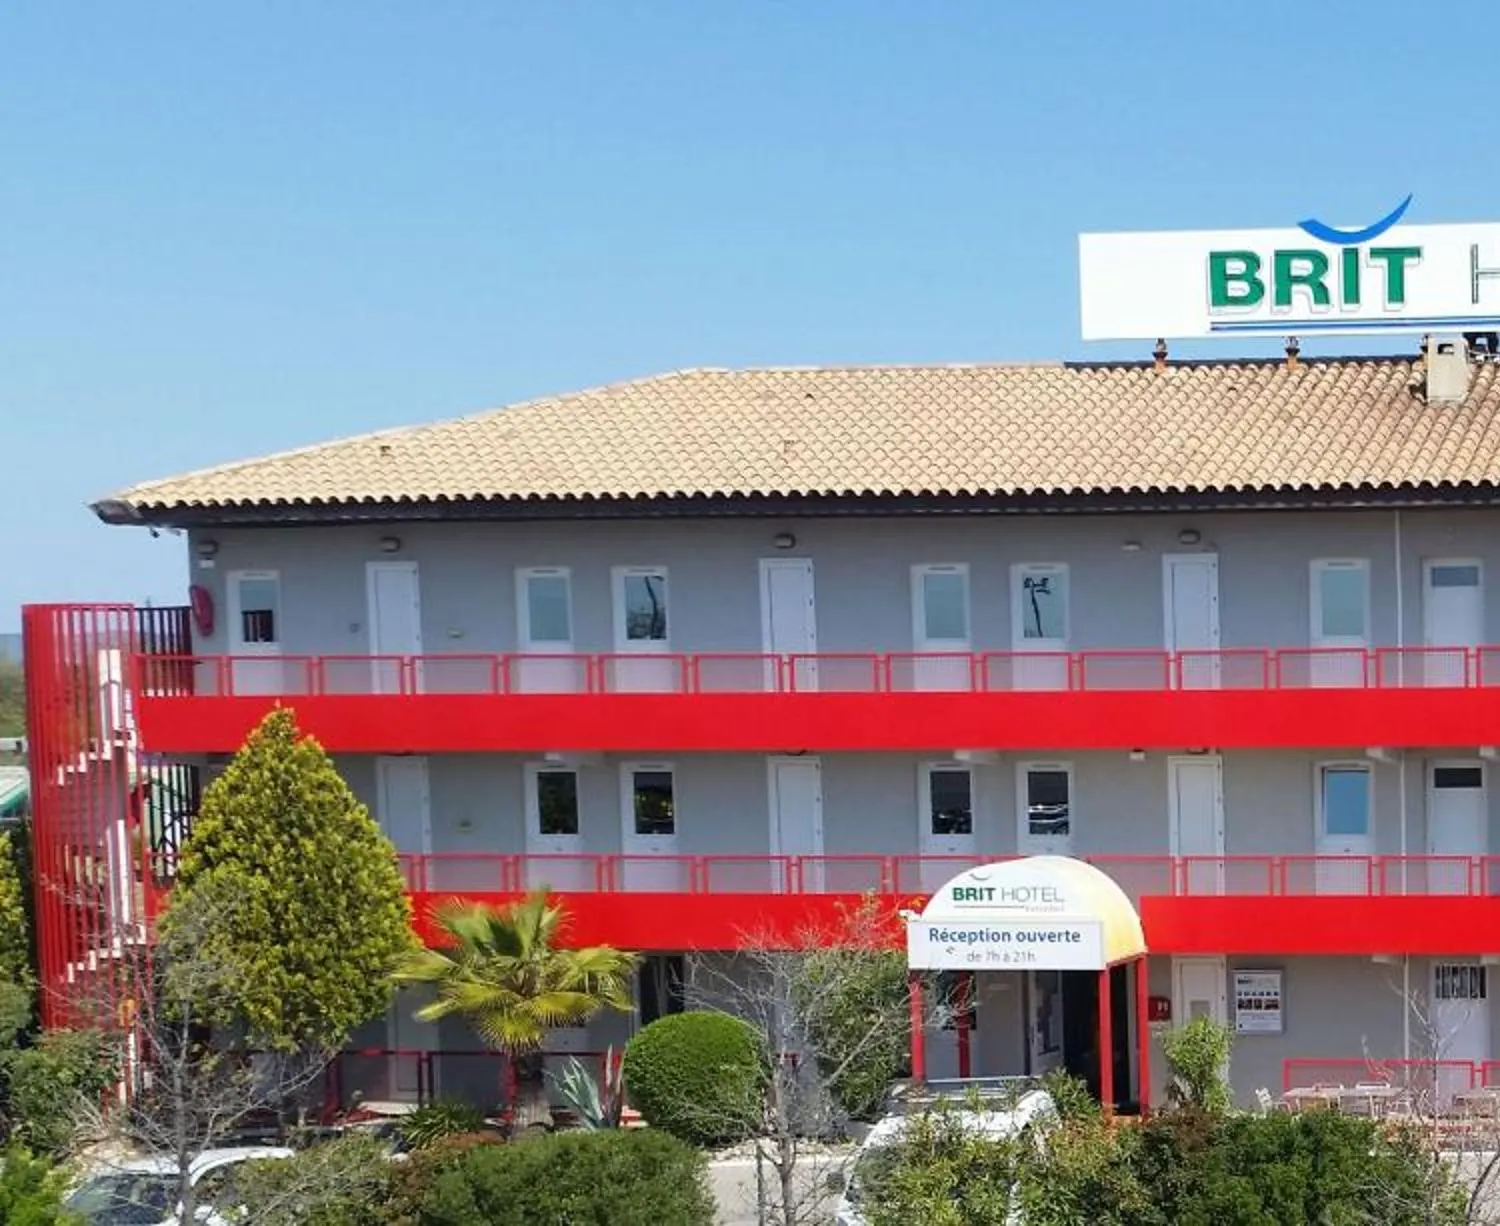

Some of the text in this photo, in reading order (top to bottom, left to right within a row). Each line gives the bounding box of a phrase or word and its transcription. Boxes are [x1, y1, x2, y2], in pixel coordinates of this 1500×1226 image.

[1208, 247, 1422, 308] BRIT
[952, 886, 1065, 902] BRIT HOTEL
[928, 928, 1081, 945] Réception ouverte
[966, 951, 1035, 962] de 7h à 21h
